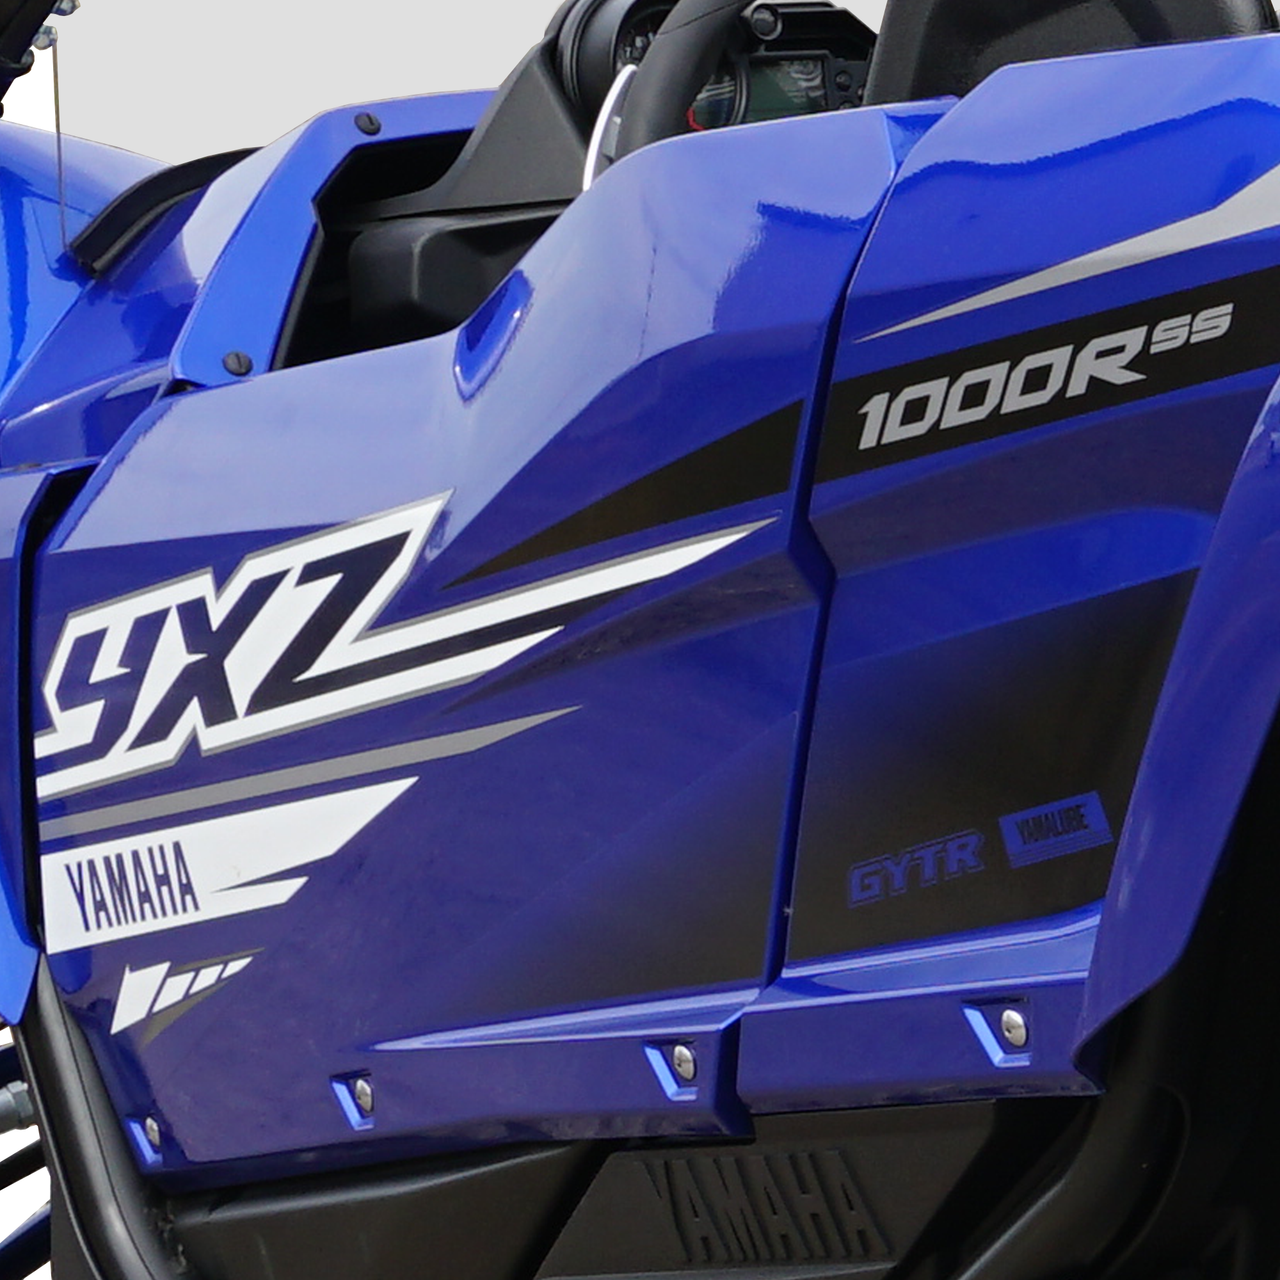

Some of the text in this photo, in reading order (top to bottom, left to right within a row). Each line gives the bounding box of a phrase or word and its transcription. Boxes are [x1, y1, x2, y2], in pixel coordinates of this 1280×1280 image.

[40, 522, 416, 762] YXZ
[65, 841, 200, 932] YAMAHA
[849, 828, 985, 909] GYTR
[634, 1150, 893, 1262] YAMAHA
